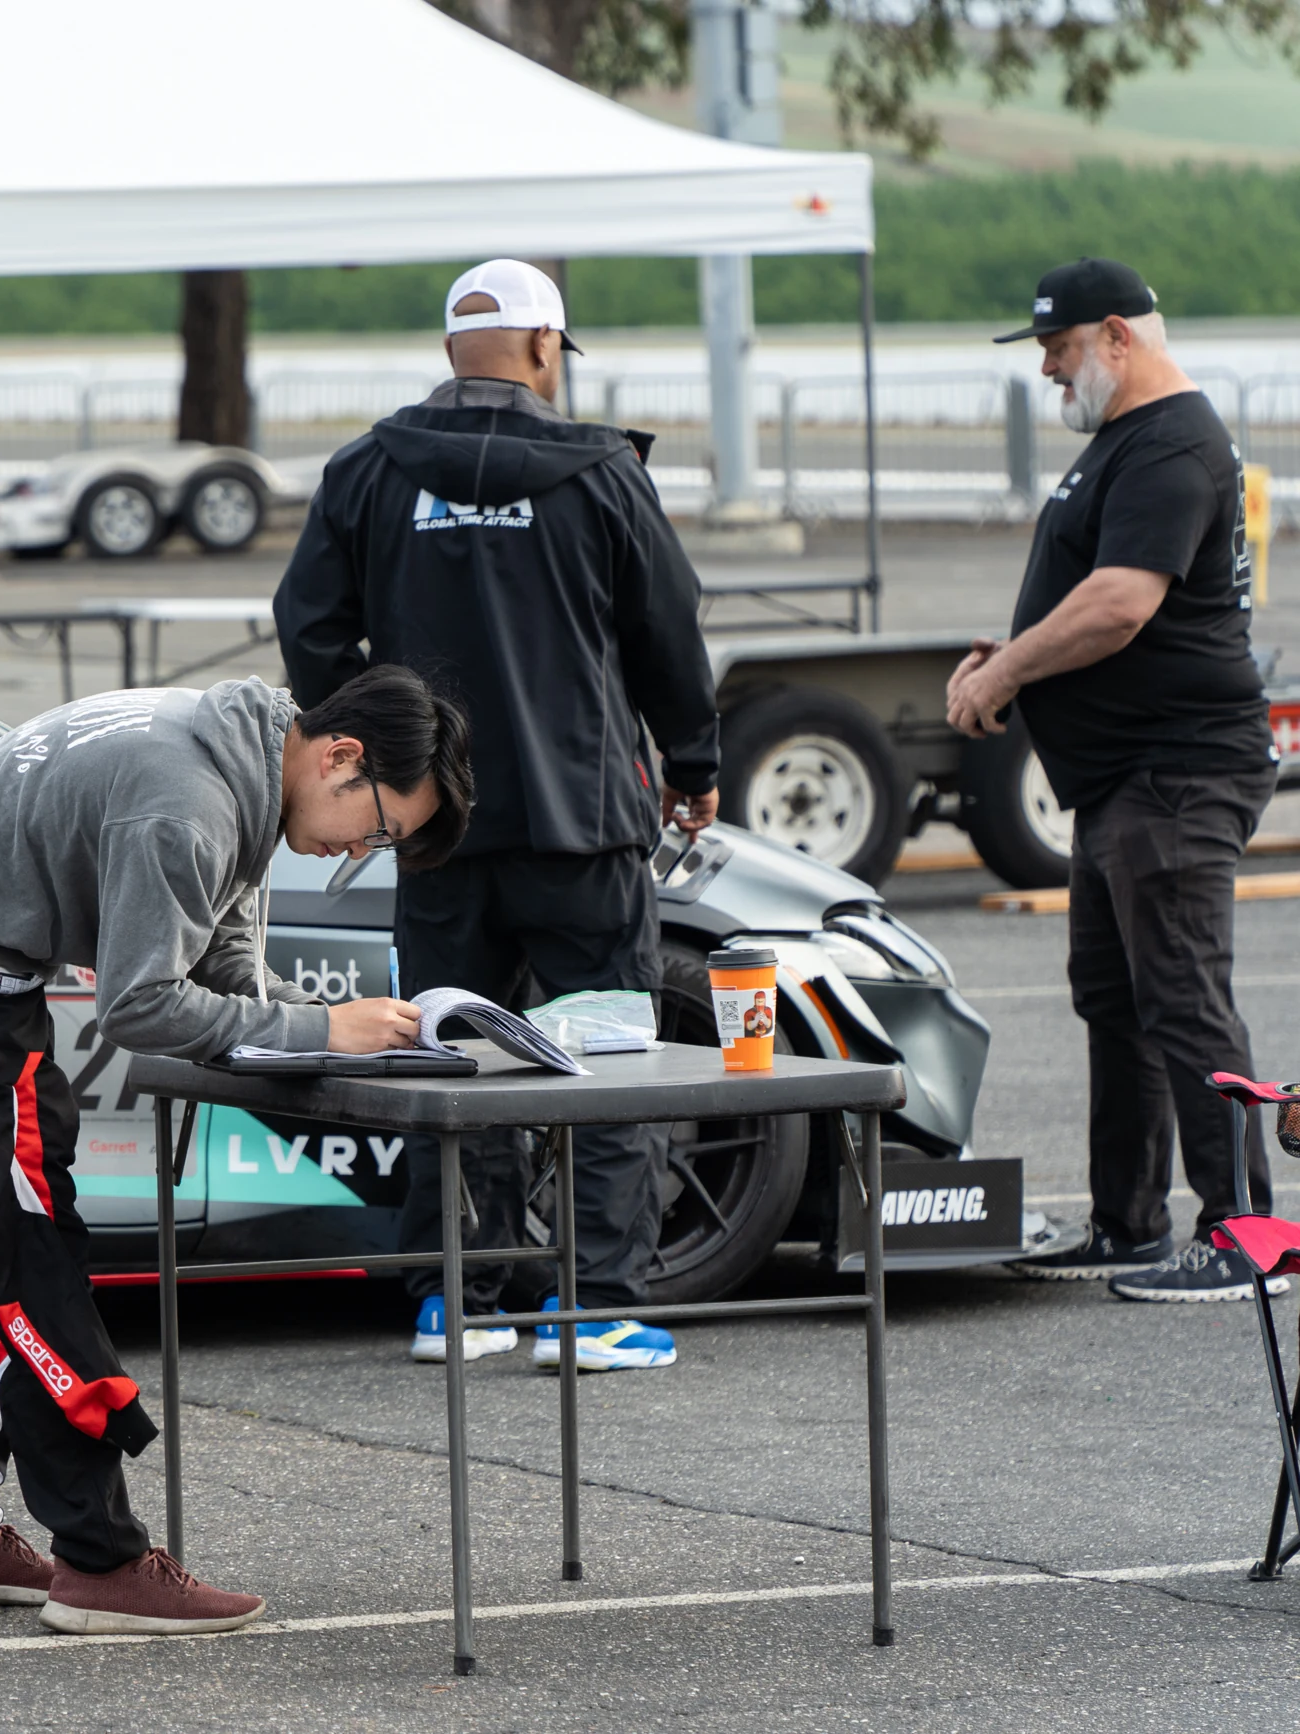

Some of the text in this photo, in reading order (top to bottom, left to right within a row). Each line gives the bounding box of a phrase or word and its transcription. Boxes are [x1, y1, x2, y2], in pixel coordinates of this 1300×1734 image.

[415, 515, 533, 531] GLOBAL TIME ATTACK
[296, 959, 362, 1001] bbt
[89, 1139, 138, 1155] Garrett
[227, 1135, 405, 1175] LVRY
[882, 1186, 988, 1226] AVOENG.
[8, 1316, 73, 1397] sparco
